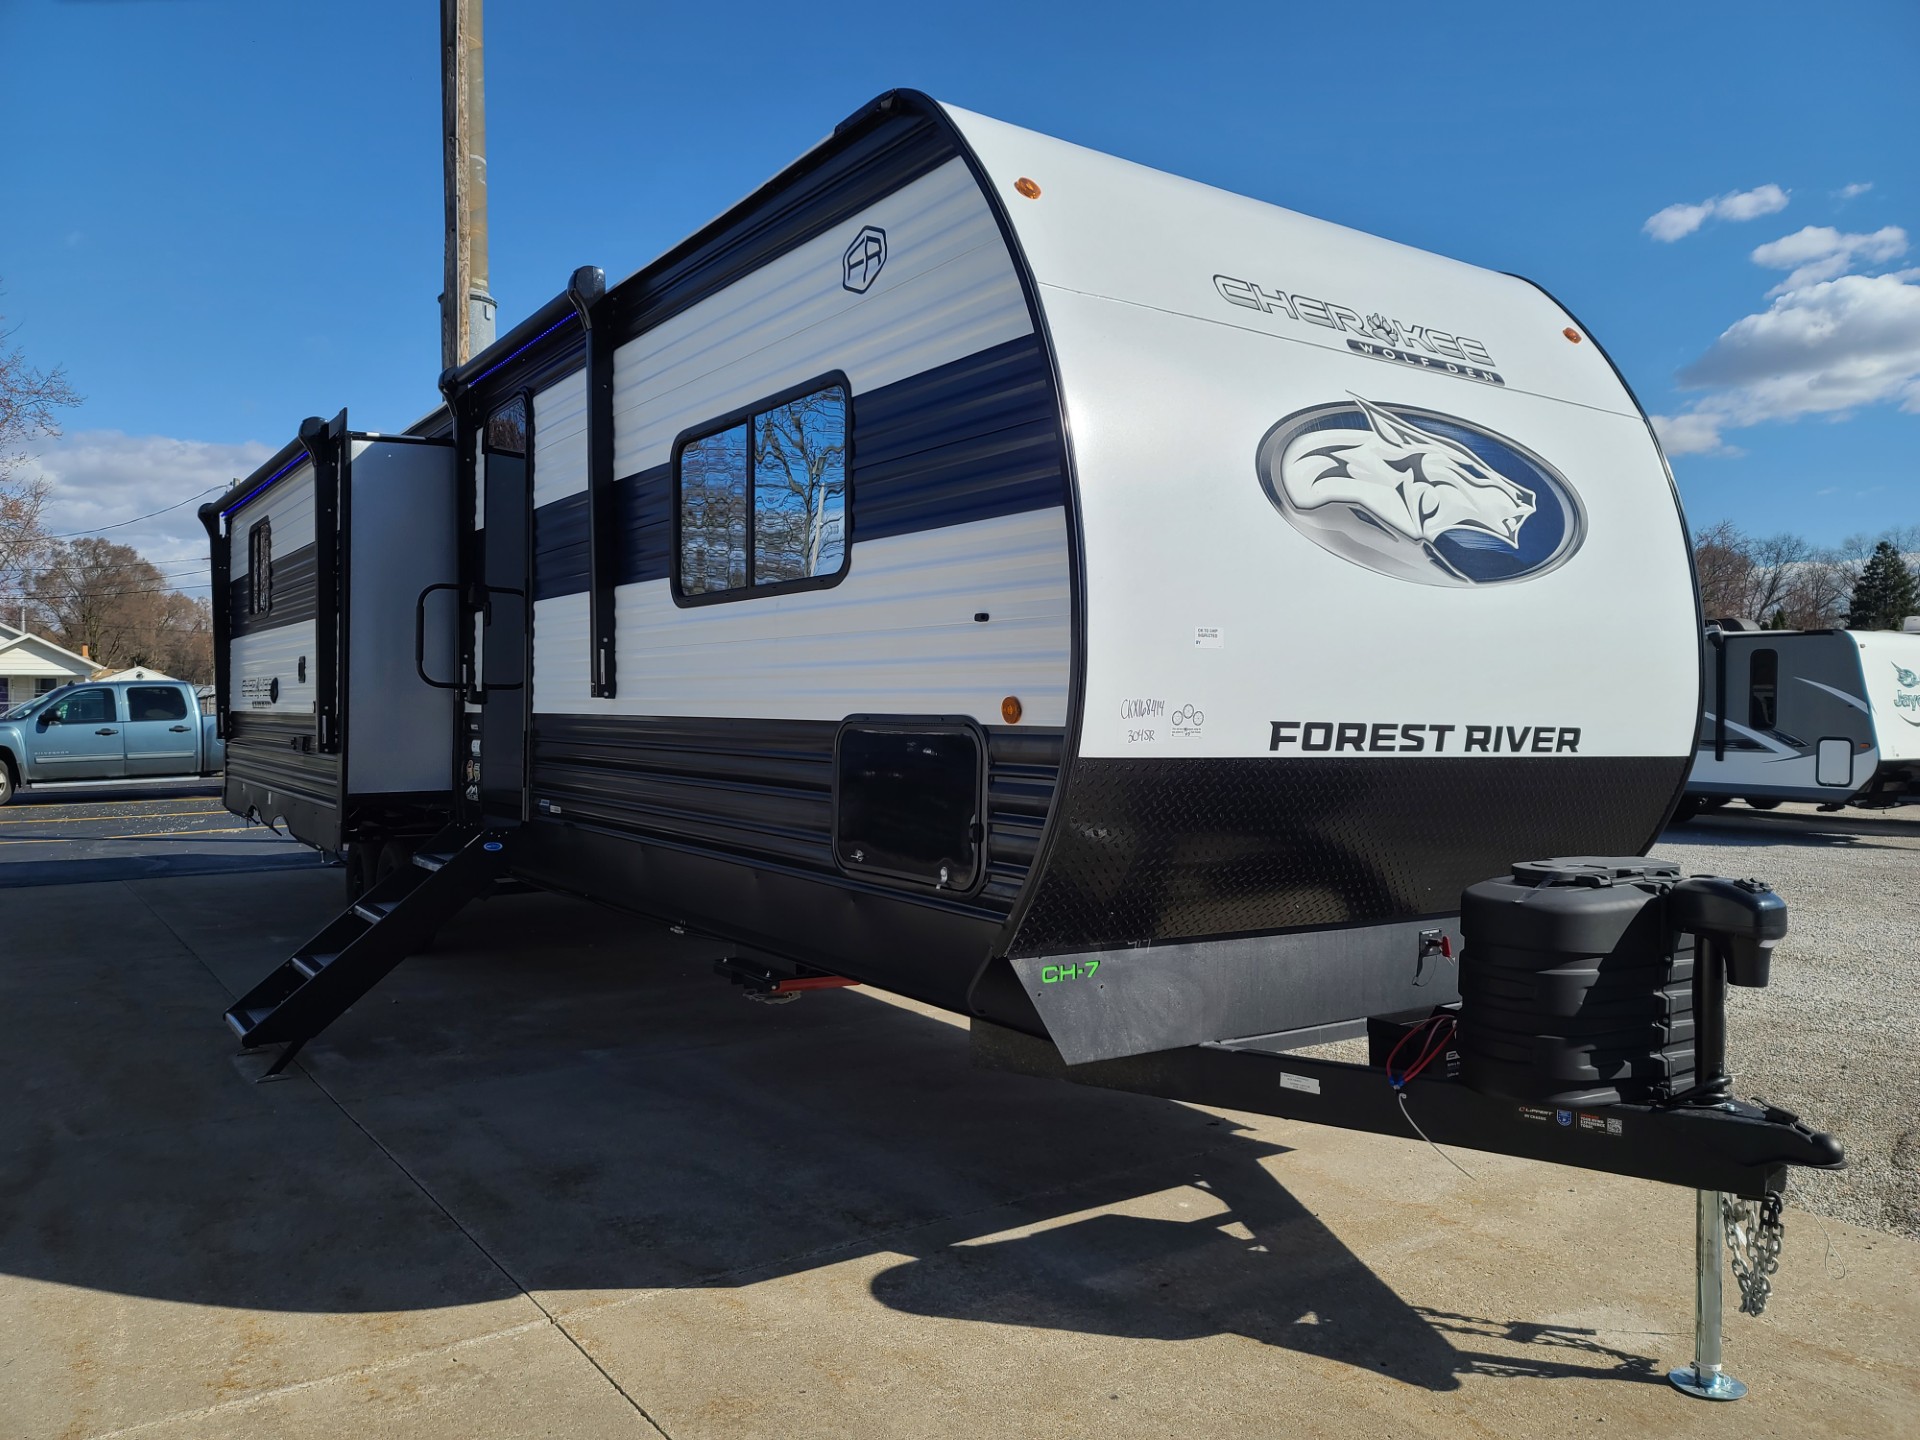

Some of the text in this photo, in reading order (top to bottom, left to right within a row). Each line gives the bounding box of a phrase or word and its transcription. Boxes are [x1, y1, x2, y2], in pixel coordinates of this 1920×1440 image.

[1359, 341, 1495, 383] WOLF DEN
[1269, 720, 1582, 753] FOREST RIVER
[1041, 960, 1101, 984] CH-7
